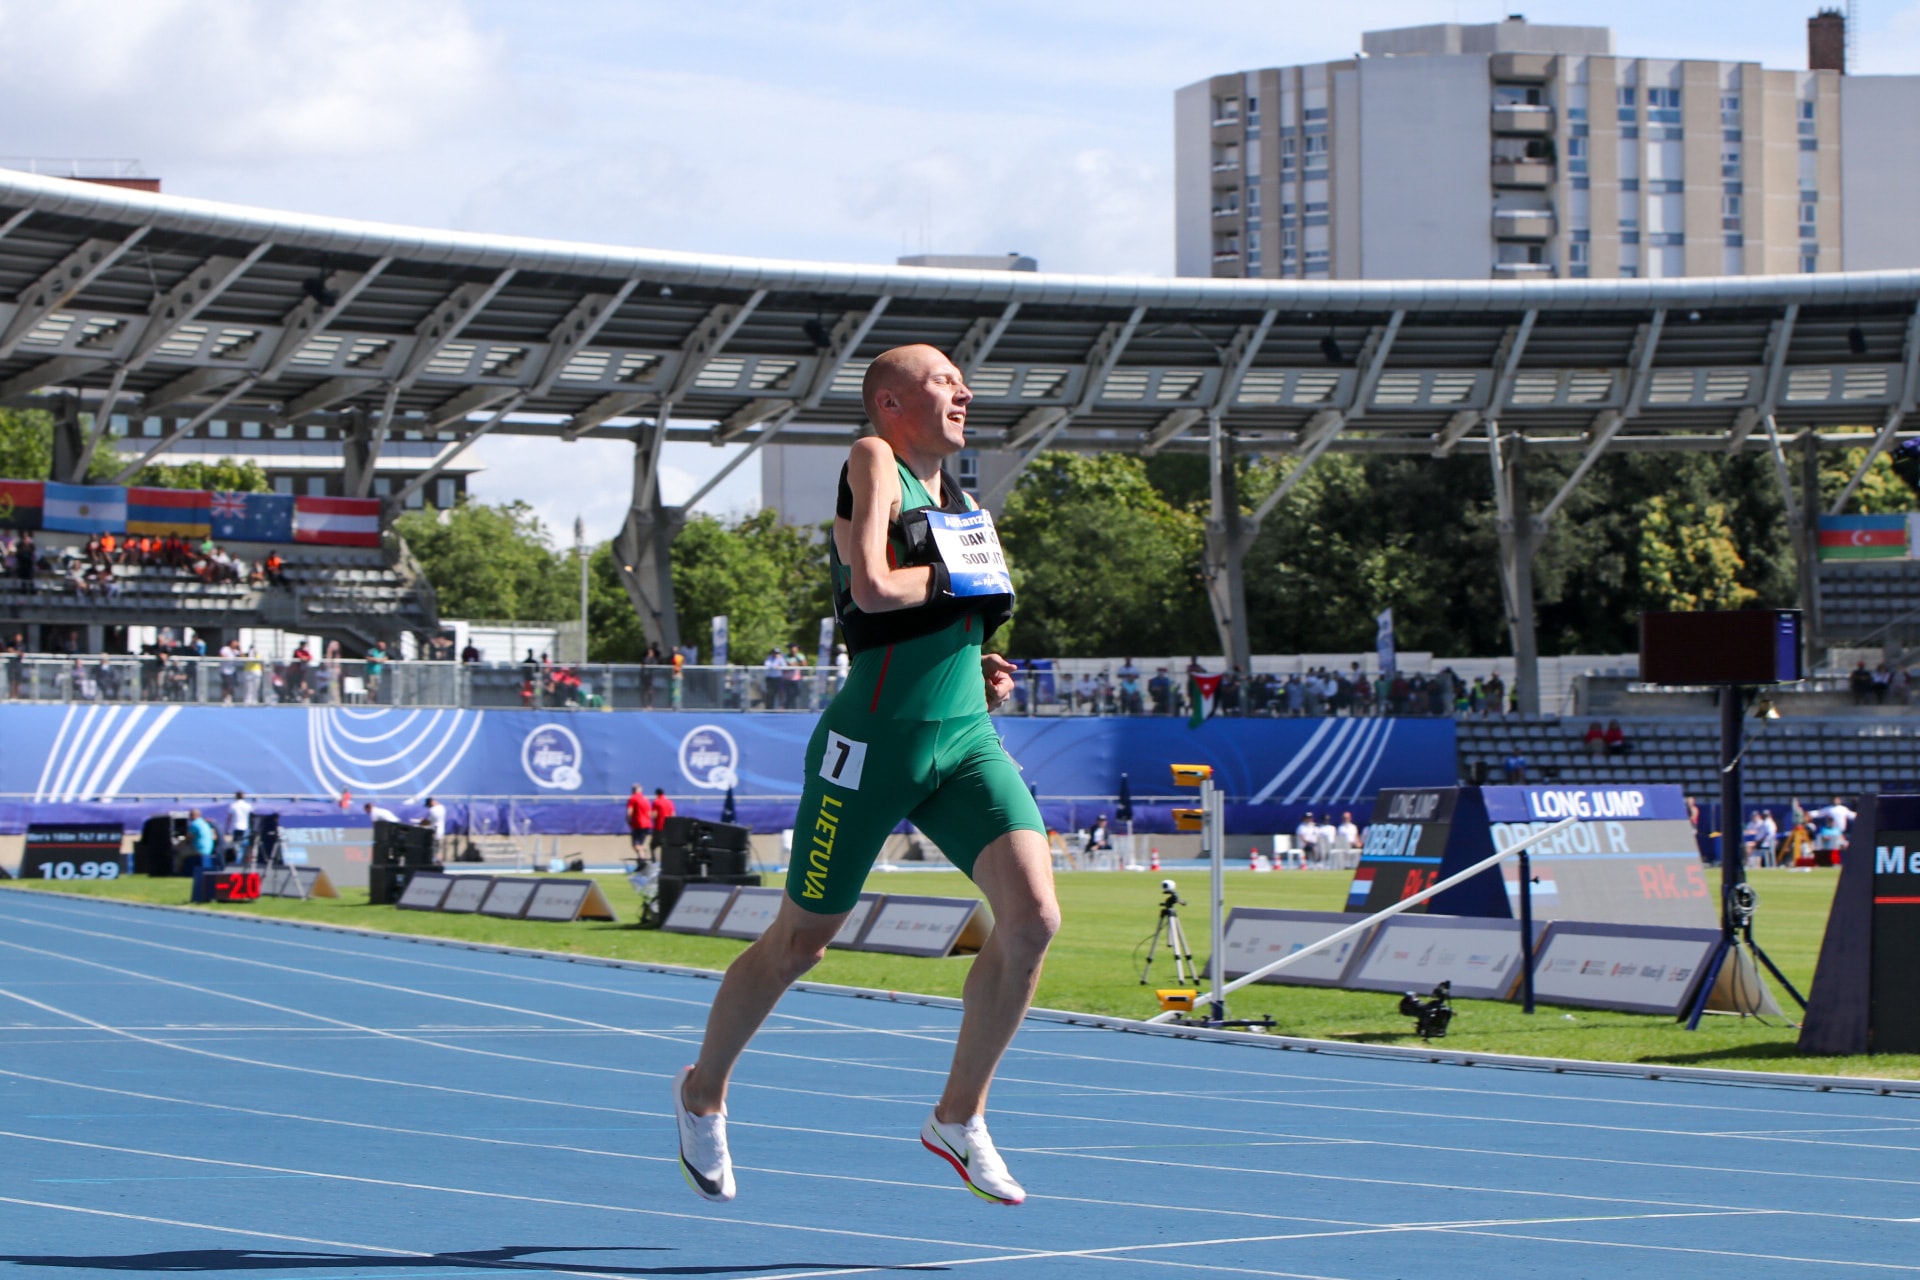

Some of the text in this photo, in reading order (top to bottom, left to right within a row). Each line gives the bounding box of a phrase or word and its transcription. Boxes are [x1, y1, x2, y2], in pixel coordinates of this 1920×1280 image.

[831, 740, 851, 779] 7
[1531, 790, 1644, 817] LONG JUMP
[802, 795, 843, 899] LIETUVA
[1605, 821, 1631, 853] R
[38, 861, 120, 880] 10.99
[215, 872, 261, 899] -2.0
[1637, 864, 1708, 900] Rk.5
